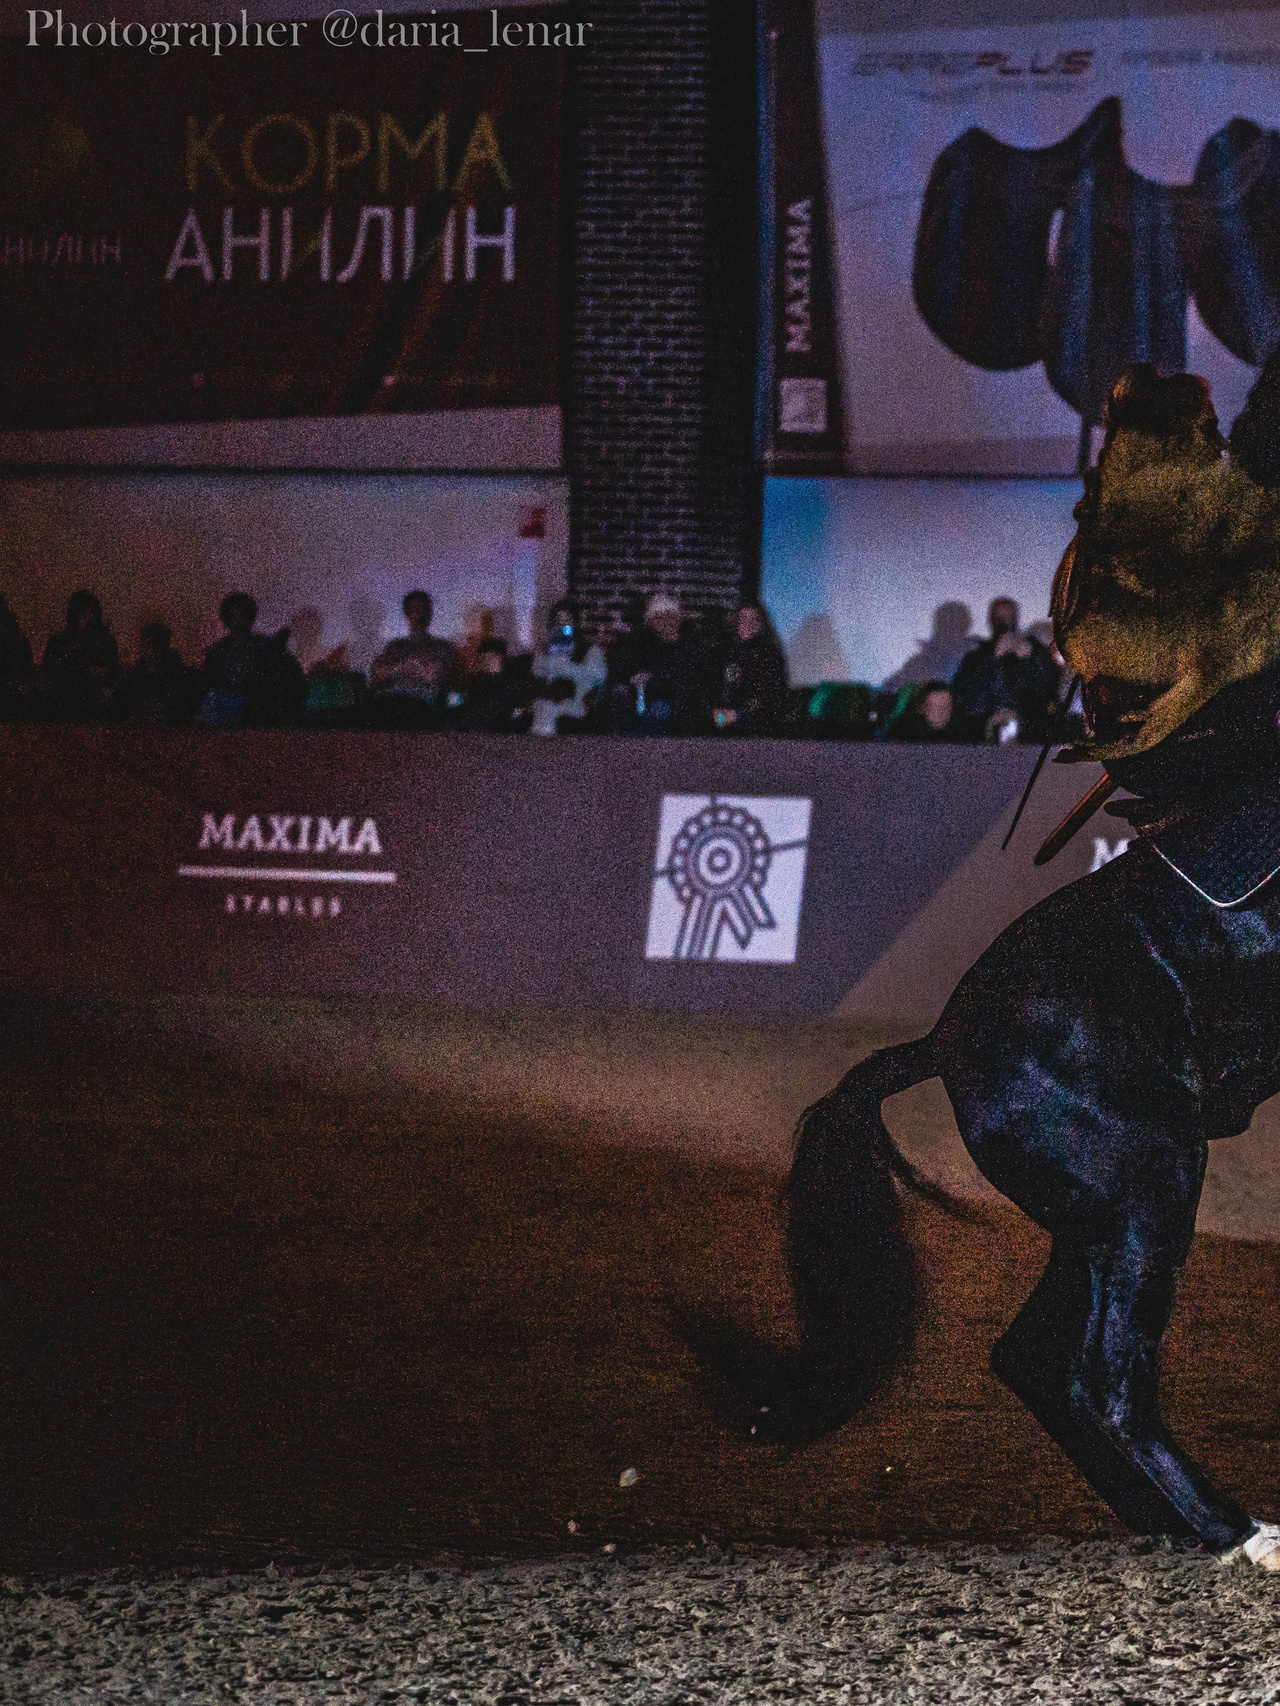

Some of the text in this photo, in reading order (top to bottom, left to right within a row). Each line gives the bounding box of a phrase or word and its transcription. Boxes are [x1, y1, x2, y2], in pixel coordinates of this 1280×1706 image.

[185, 111, 515, 194] КОРМА
[0, 232, 121, 268] НИЛИН
[164, 204, 518, 283] АНИЛИН
[784, 197, 812, 352] MAXIMA
[198, 811, 383, 855] MAXIMA
